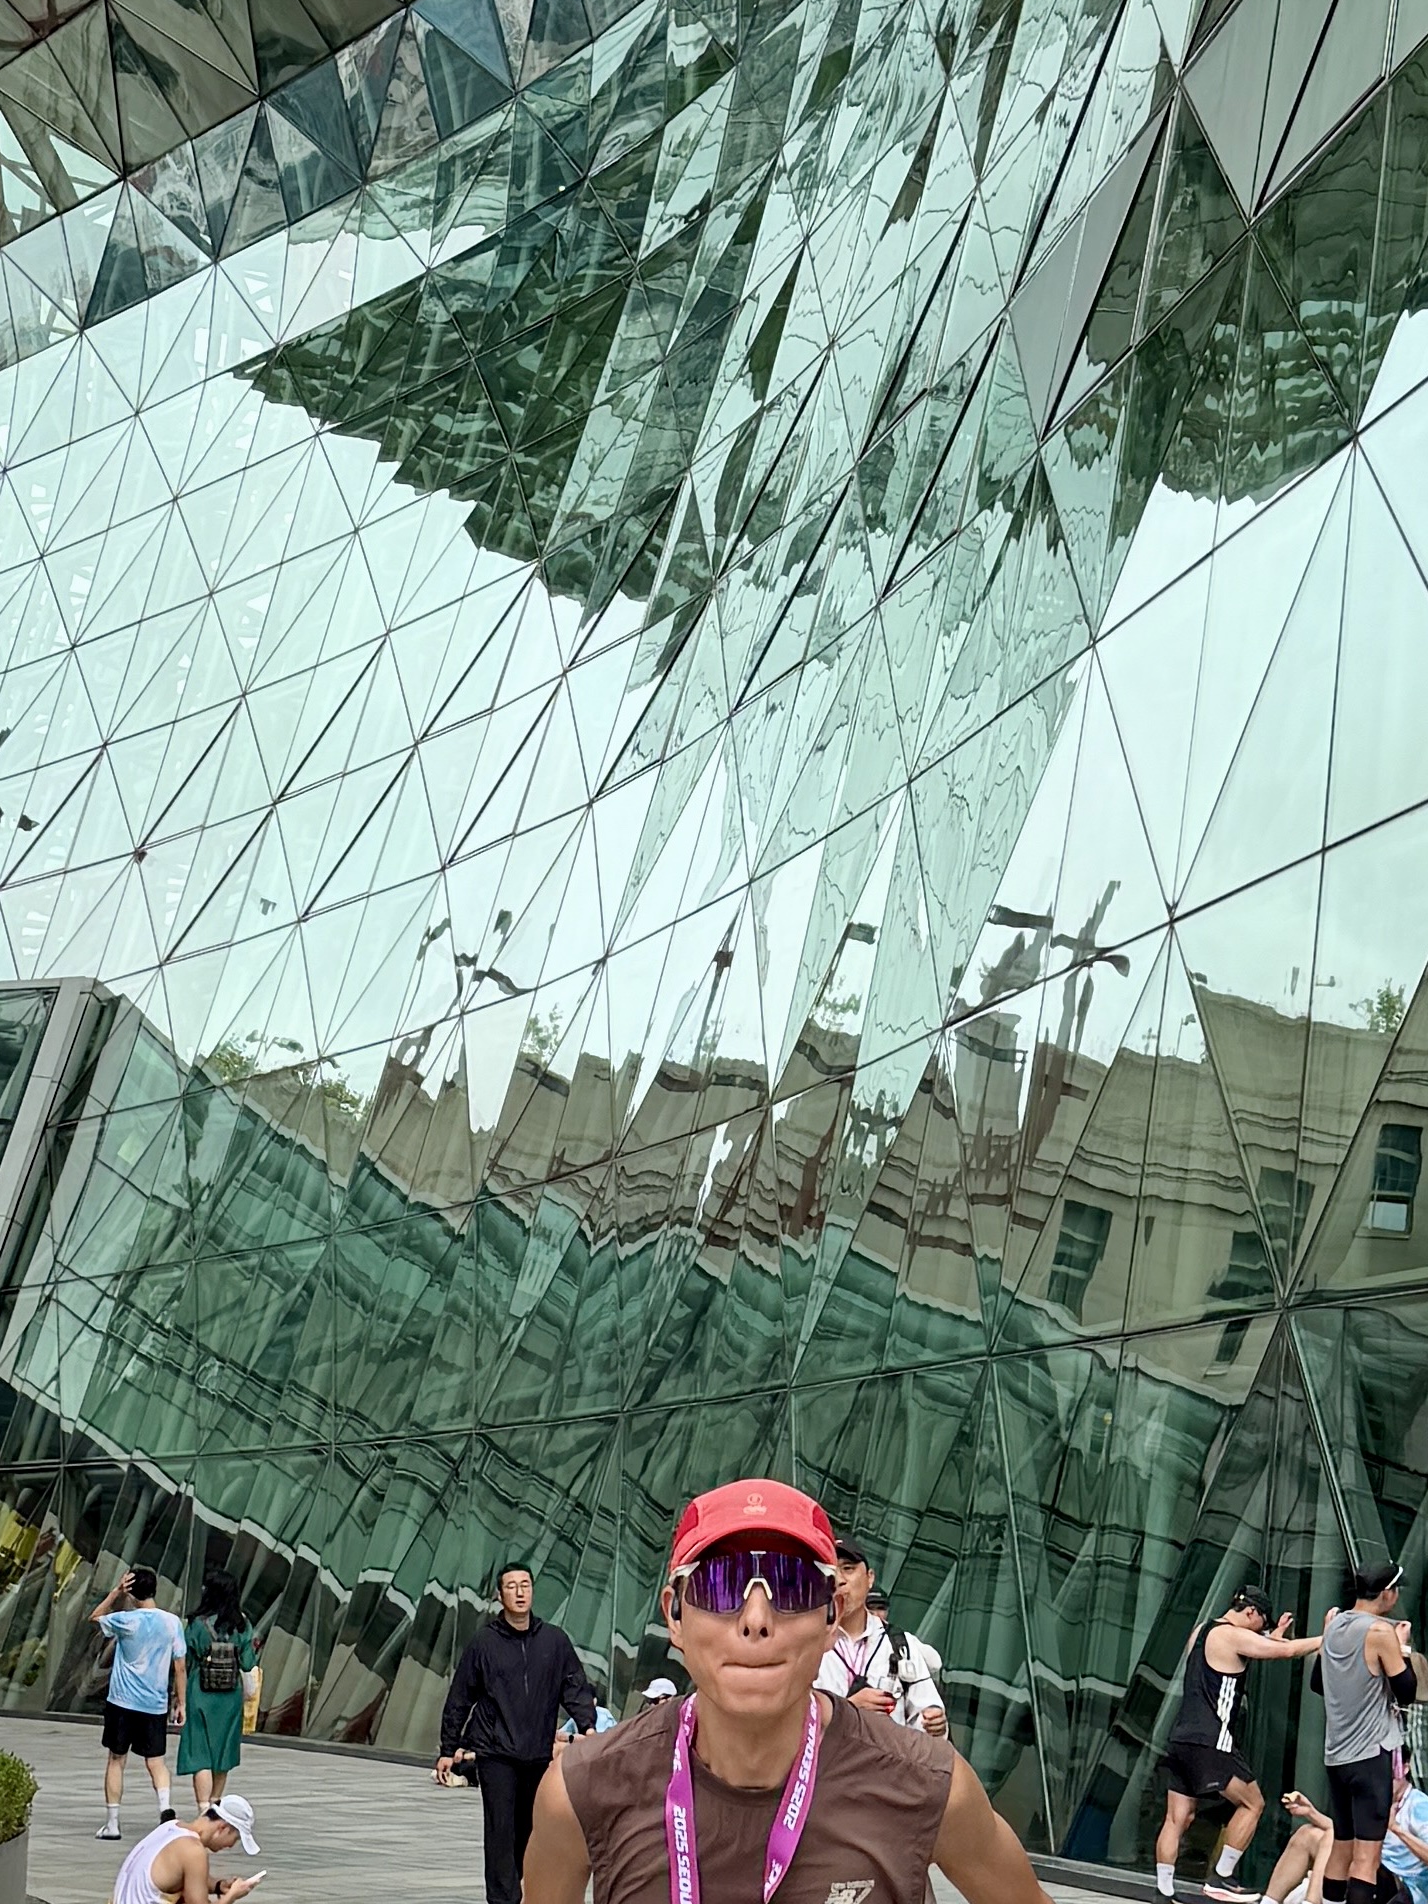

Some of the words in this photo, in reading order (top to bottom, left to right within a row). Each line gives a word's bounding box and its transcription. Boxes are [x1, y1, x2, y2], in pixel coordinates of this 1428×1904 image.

[783, 1784, 807, 1831] 2025
[798, 1721, 818, 1785] SEOUL
[673, 1804, 689, 1853] 2025
